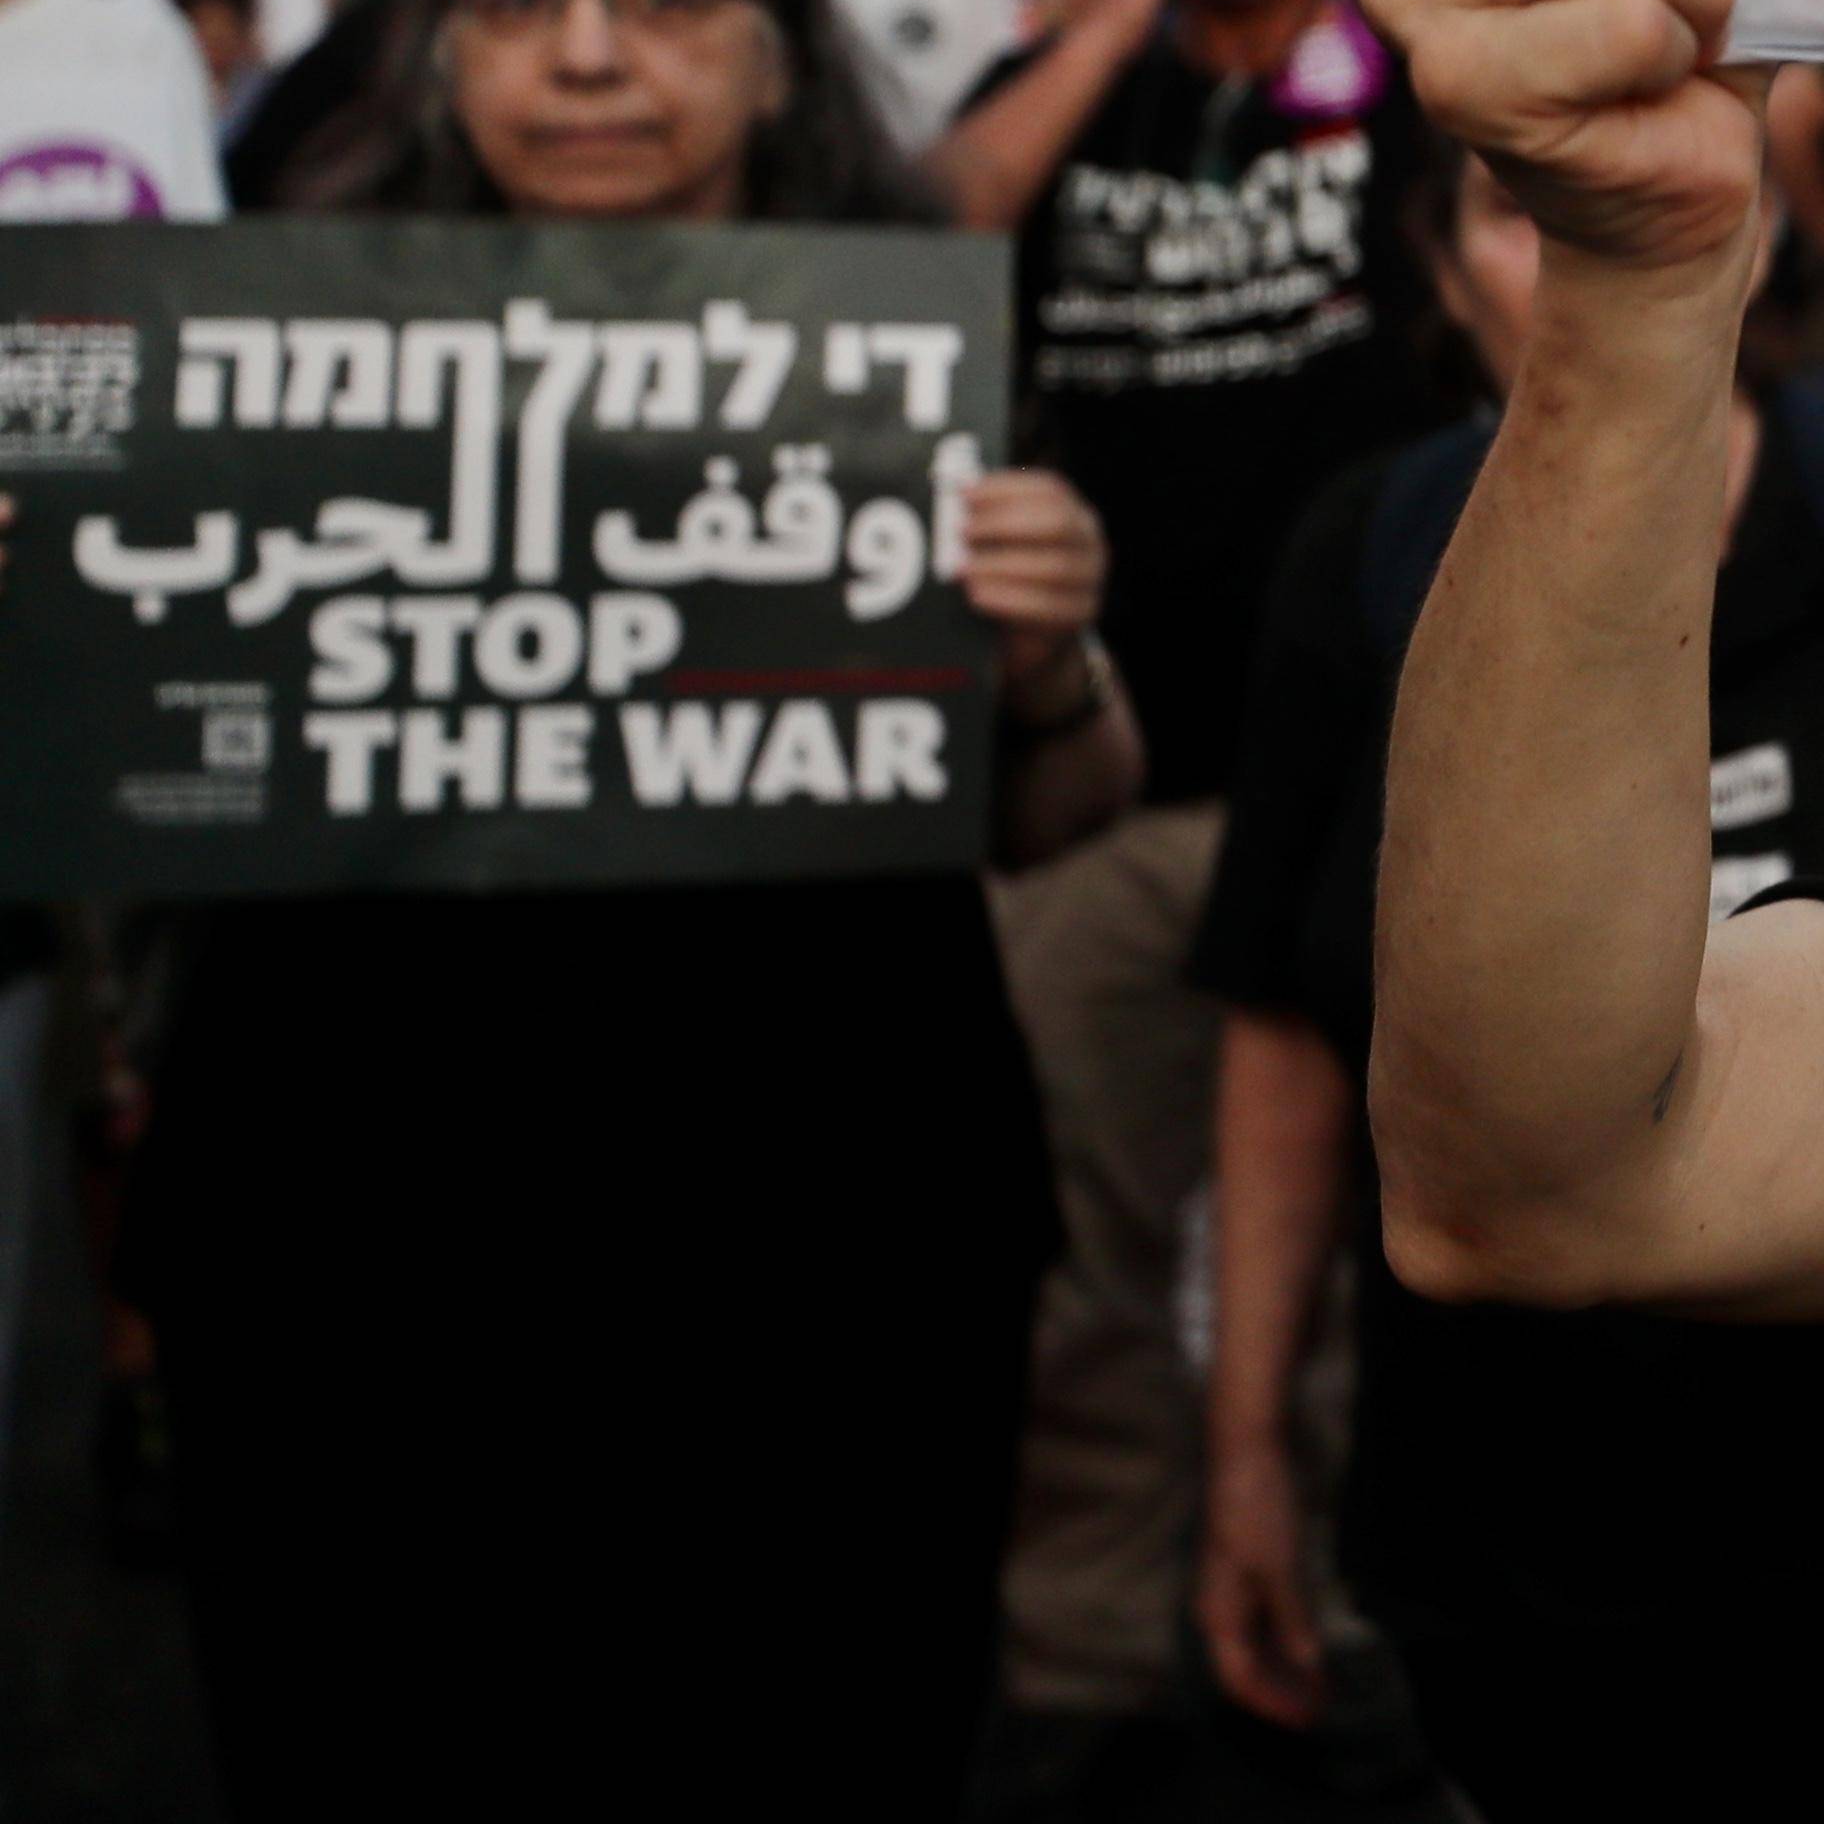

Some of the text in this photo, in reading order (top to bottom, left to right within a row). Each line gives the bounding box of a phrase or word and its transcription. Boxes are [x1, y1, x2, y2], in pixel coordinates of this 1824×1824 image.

[823, 321, 962, 431] די
[591, 431, 978, 622] أوقف
[311, 594, 679, 701] STOP
[306, 706, 592, 813] THE
[622, 701, 944, 803] WAR
